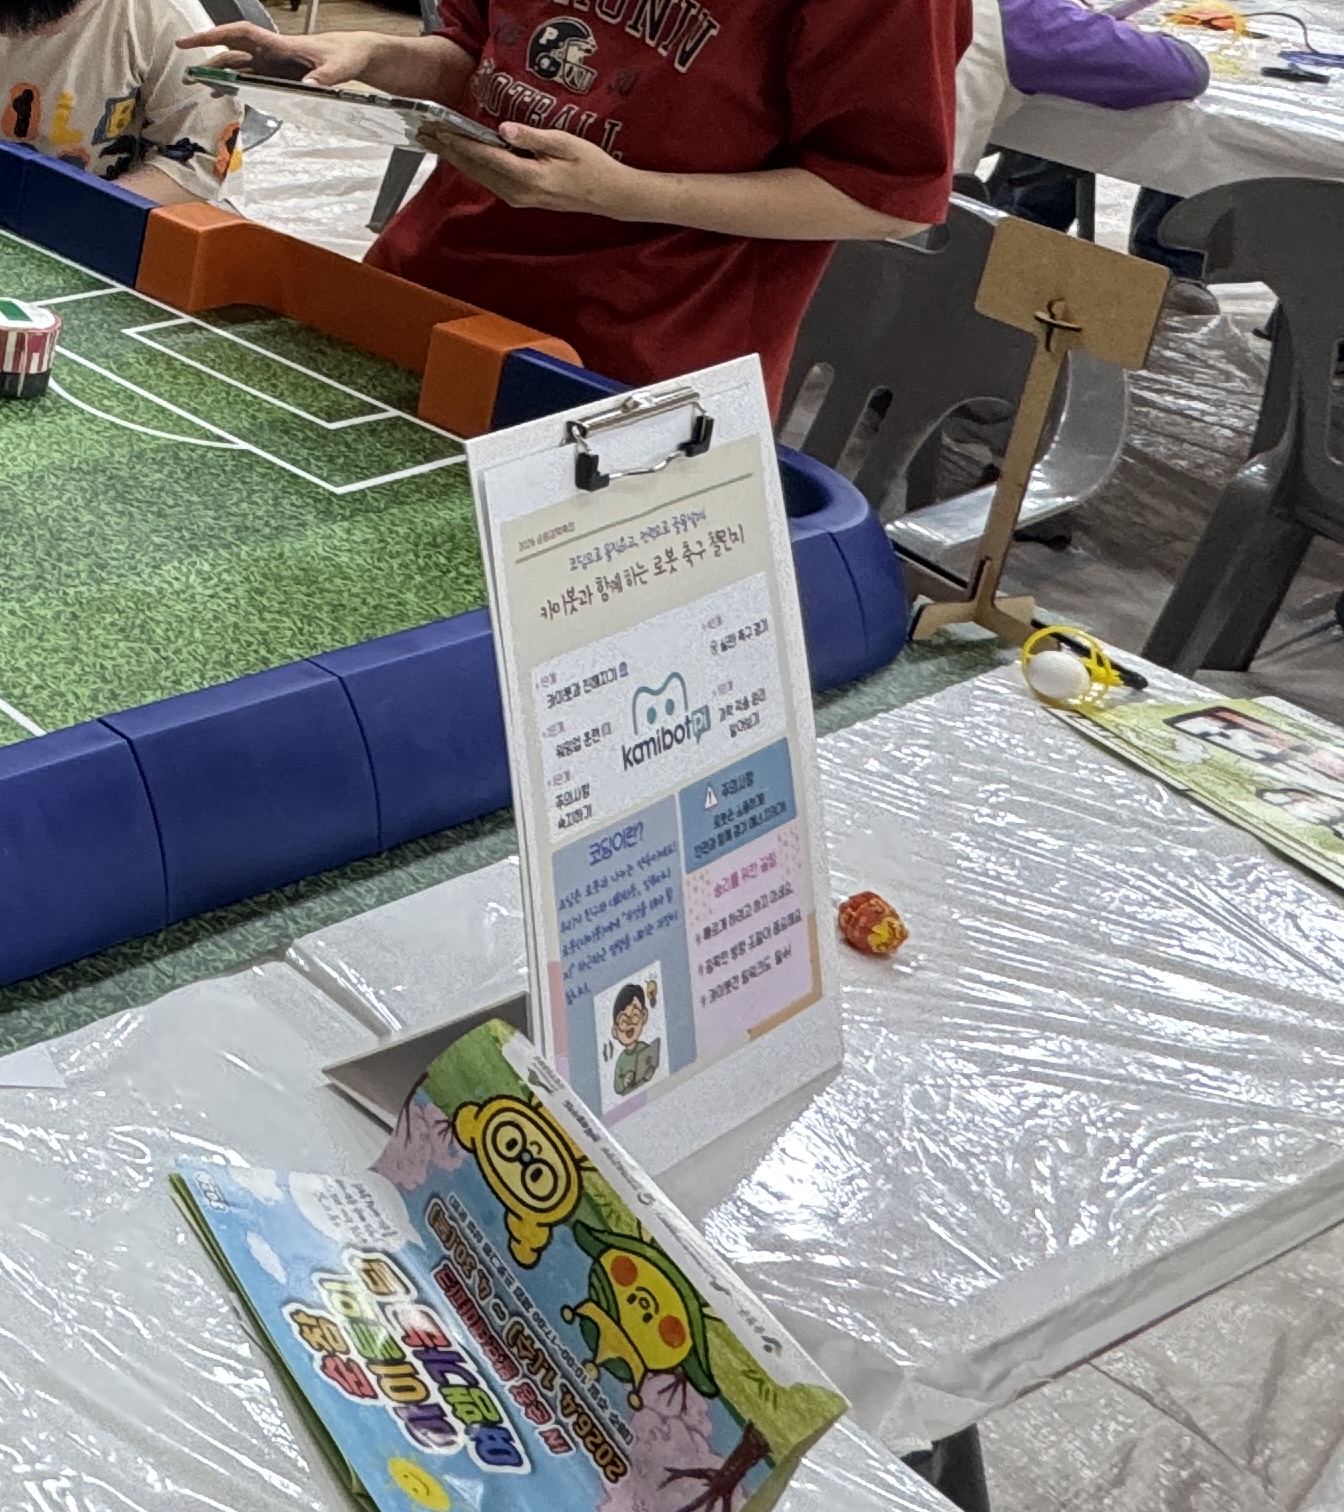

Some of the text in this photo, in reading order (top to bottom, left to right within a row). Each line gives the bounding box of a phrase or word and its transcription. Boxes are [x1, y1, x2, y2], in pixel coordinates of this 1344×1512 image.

[539, 26, 559, 45] P
[652, 548, 678, 576] 로봇
[682, 537, 706, 567] 축구
[621, 717, 691, 770] kamibot
[290, 1308, 377, 1400] 순창
[392, 1306, 524, 1467] 여행가는
[510, 1382, 553, 1426] 순창
[545, 1427, 571, 1456] IN
